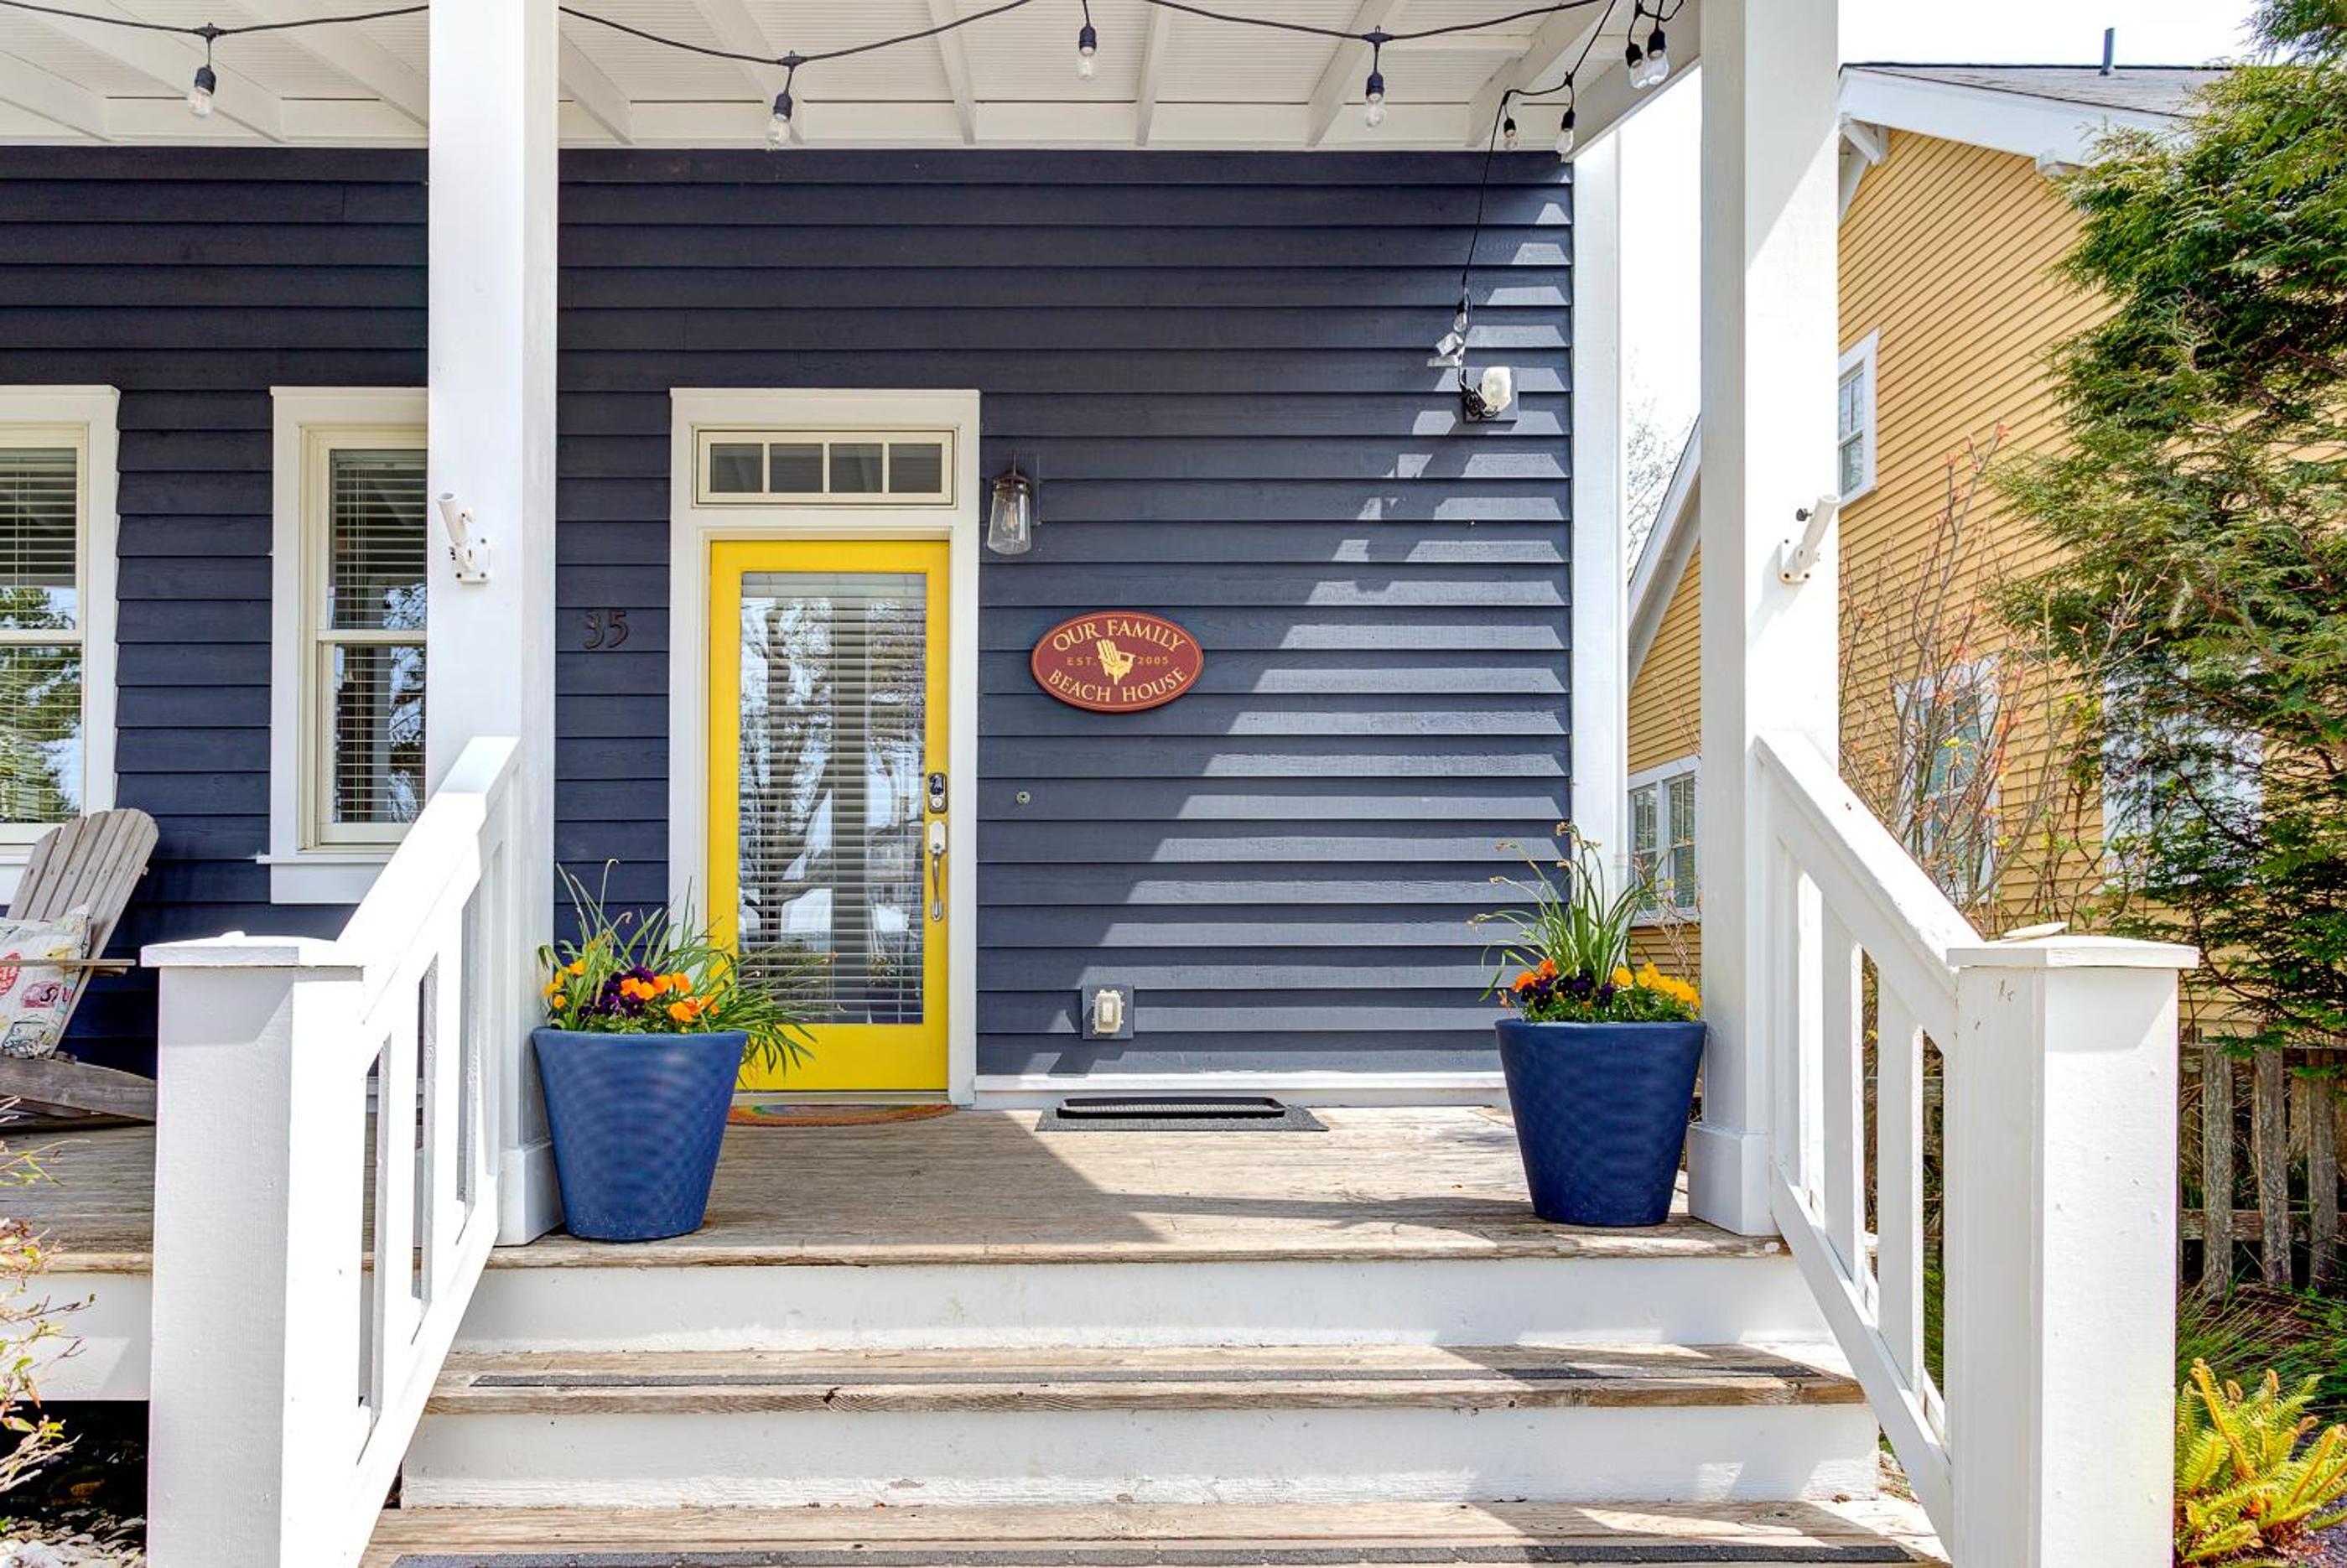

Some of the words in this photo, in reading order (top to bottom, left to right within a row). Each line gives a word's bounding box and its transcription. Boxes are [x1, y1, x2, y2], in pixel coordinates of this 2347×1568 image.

[583, 610, 629, 650] 35
[1052, 622, 1102, 652] OUR
[1106, 619, 1186, 652] FAMILY
[1067, 657, 1098, 666] EST.
[1137, 656, 1169, 665] 2005
[1048, 669, 1111, 702] BEACH
[1122, 667, 1187, 702] HOUSE
